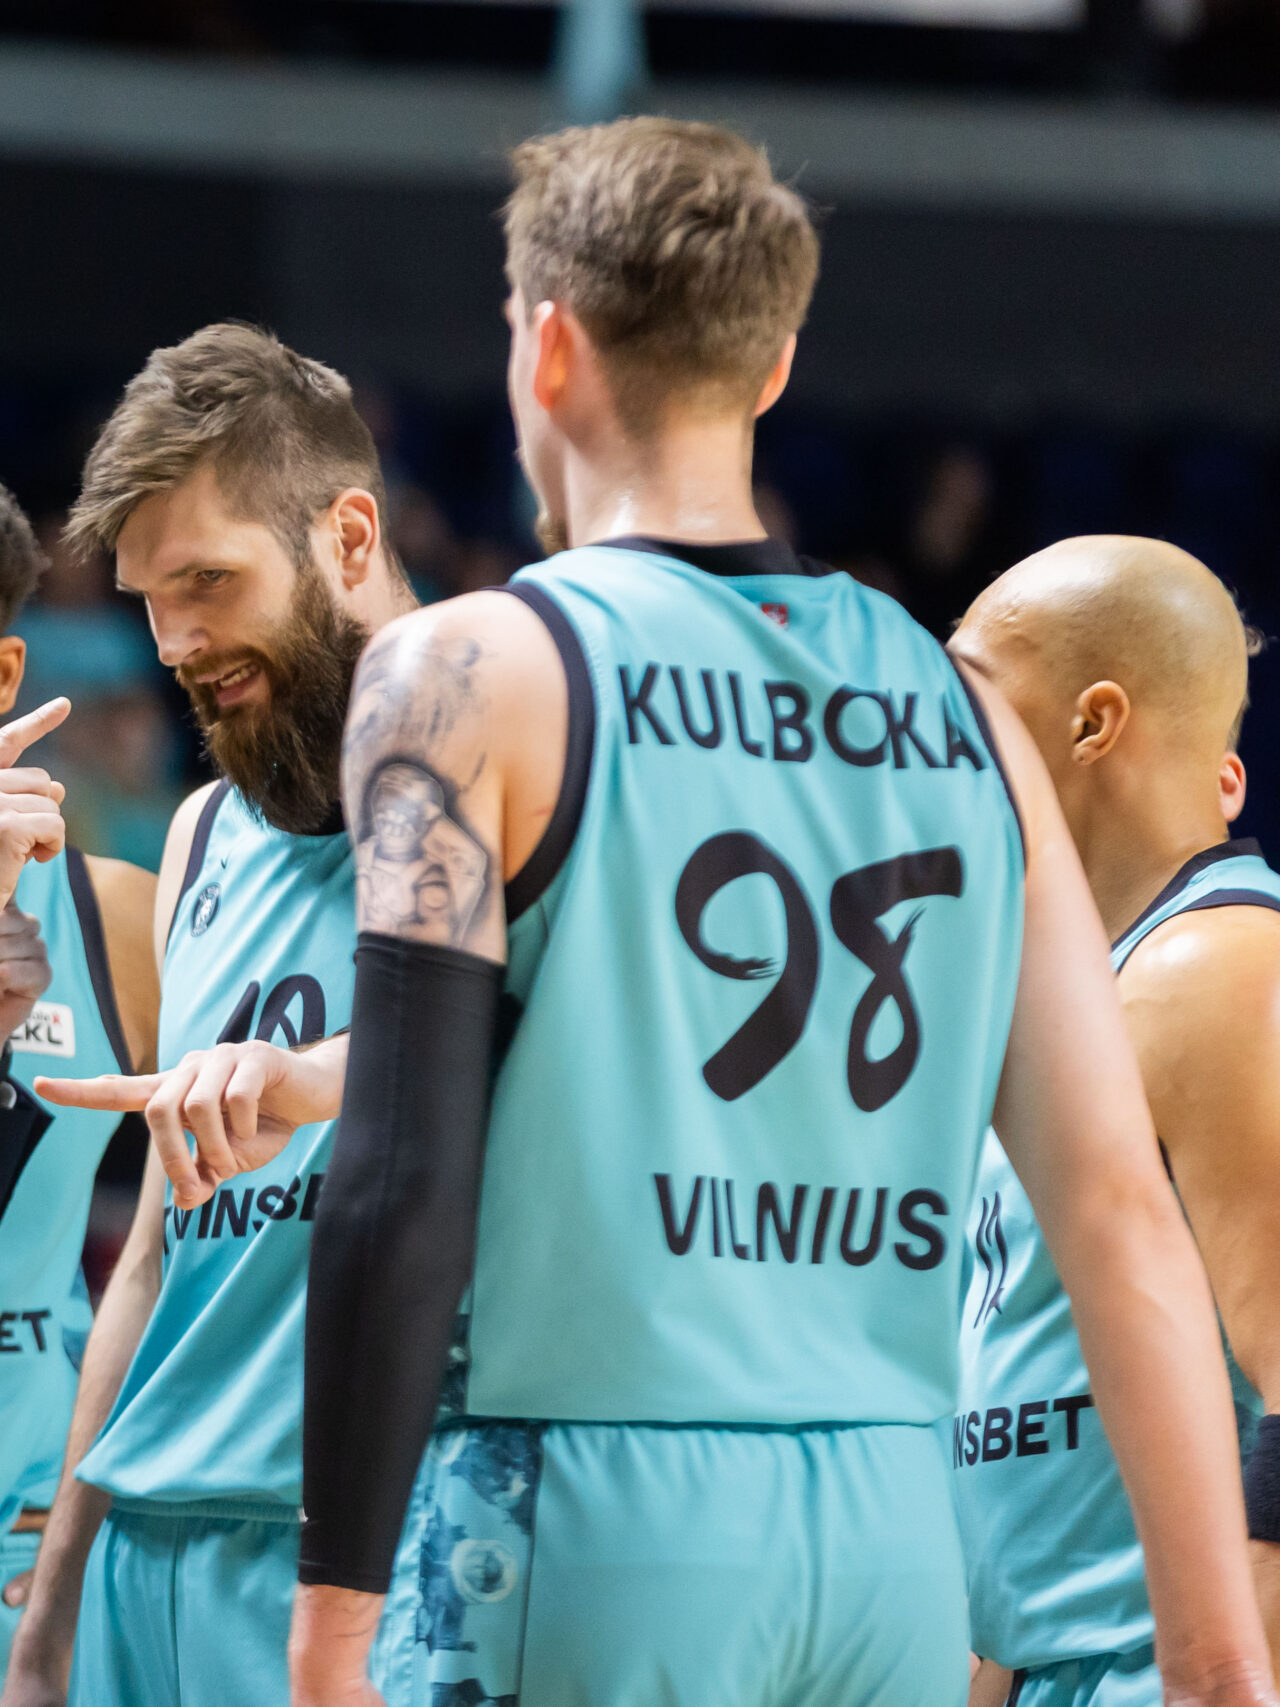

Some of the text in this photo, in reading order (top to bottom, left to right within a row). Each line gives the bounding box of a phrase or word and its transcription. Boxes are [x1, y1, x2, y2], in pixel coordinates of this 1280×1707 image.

[619, 661, 989, 772] KULBOKA
[674, 828, 964, 1113] 98
[653, 1172, 951, 1271] VILNIUS
